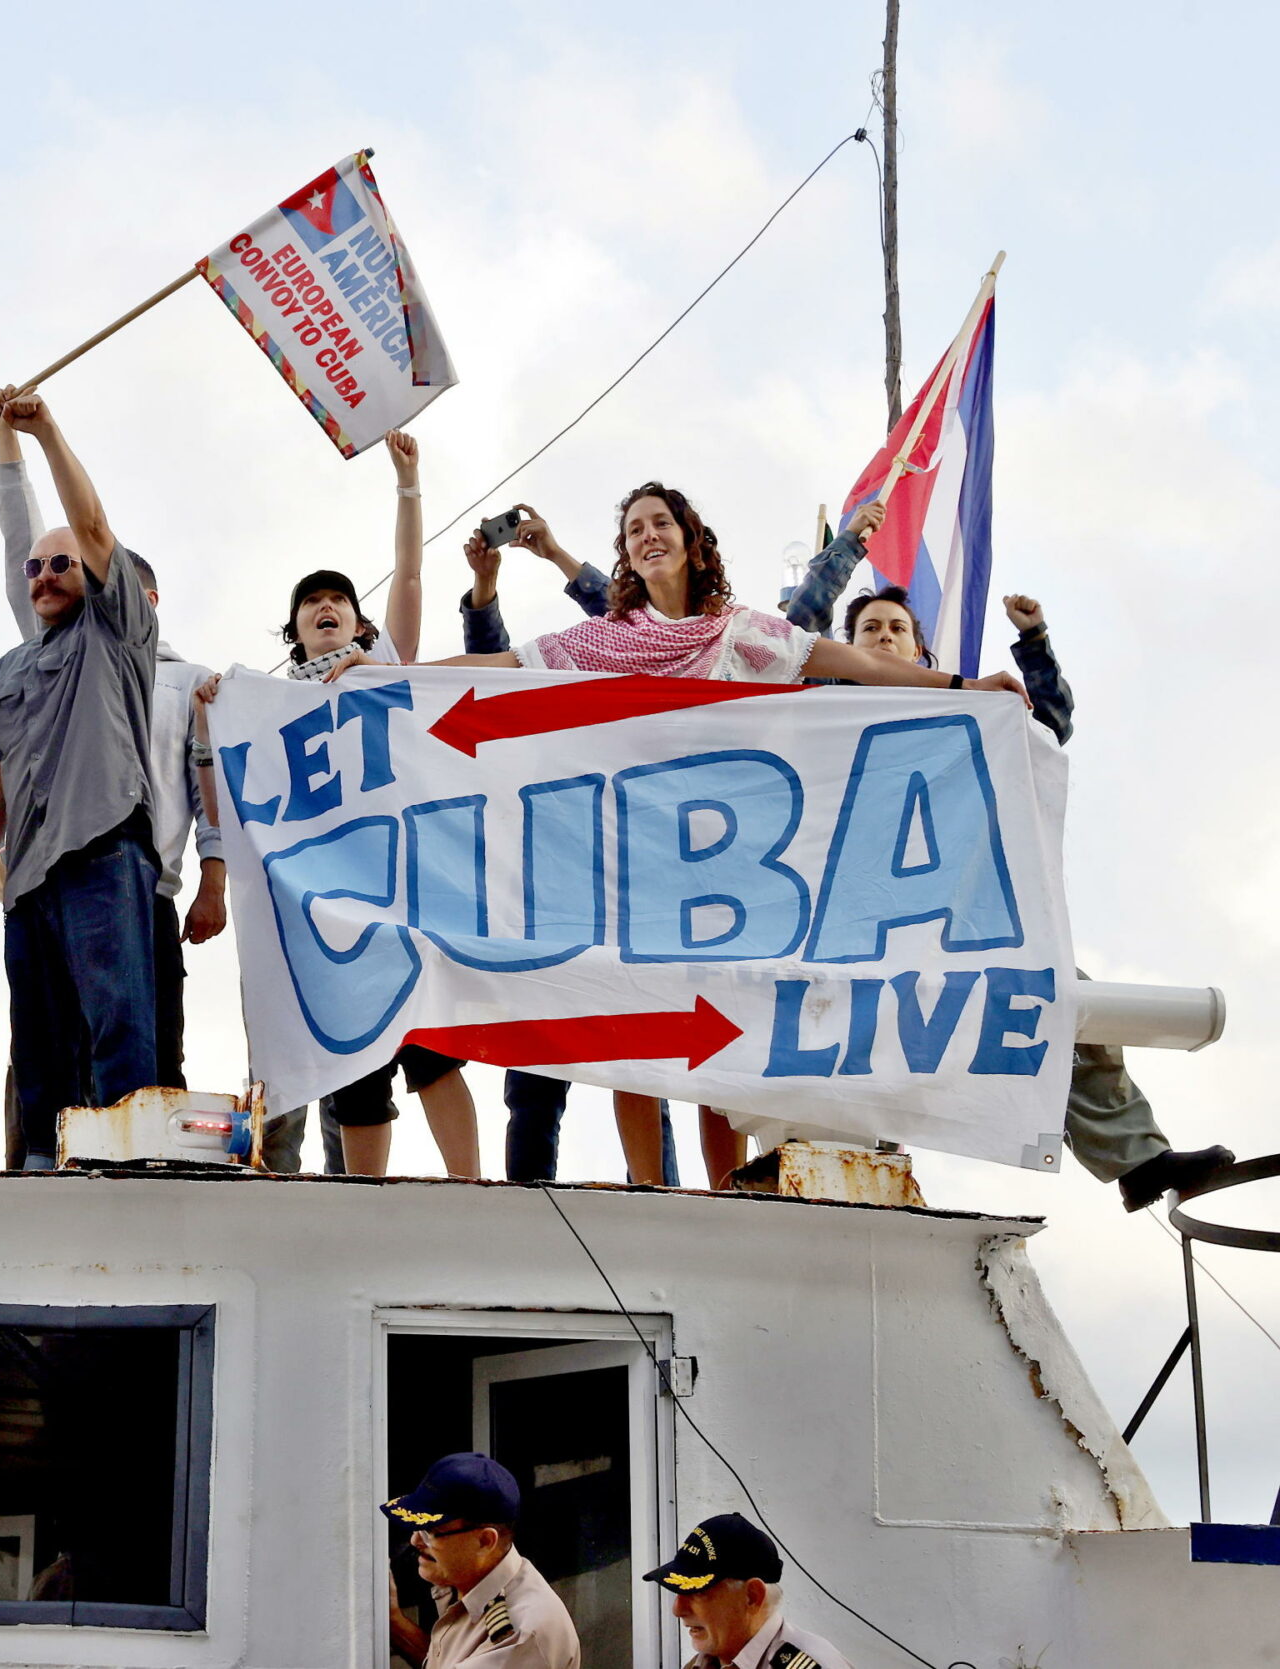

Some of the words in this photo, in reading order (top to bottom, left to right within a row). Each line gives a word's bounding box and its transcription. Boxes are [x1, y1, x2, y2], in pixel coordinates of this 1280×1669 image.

[229, 233, 304, 318] CONVOY
[292, 314, 323, 346] TO
[315, 348, 367, 409] CUBA
[271, 243, 364, 361] EUROPEAN
[218, 680, 413, 828] LET
[261, 713, 1024, 1055] CUBA
[762, 967, 1056, 1078] LIVE
